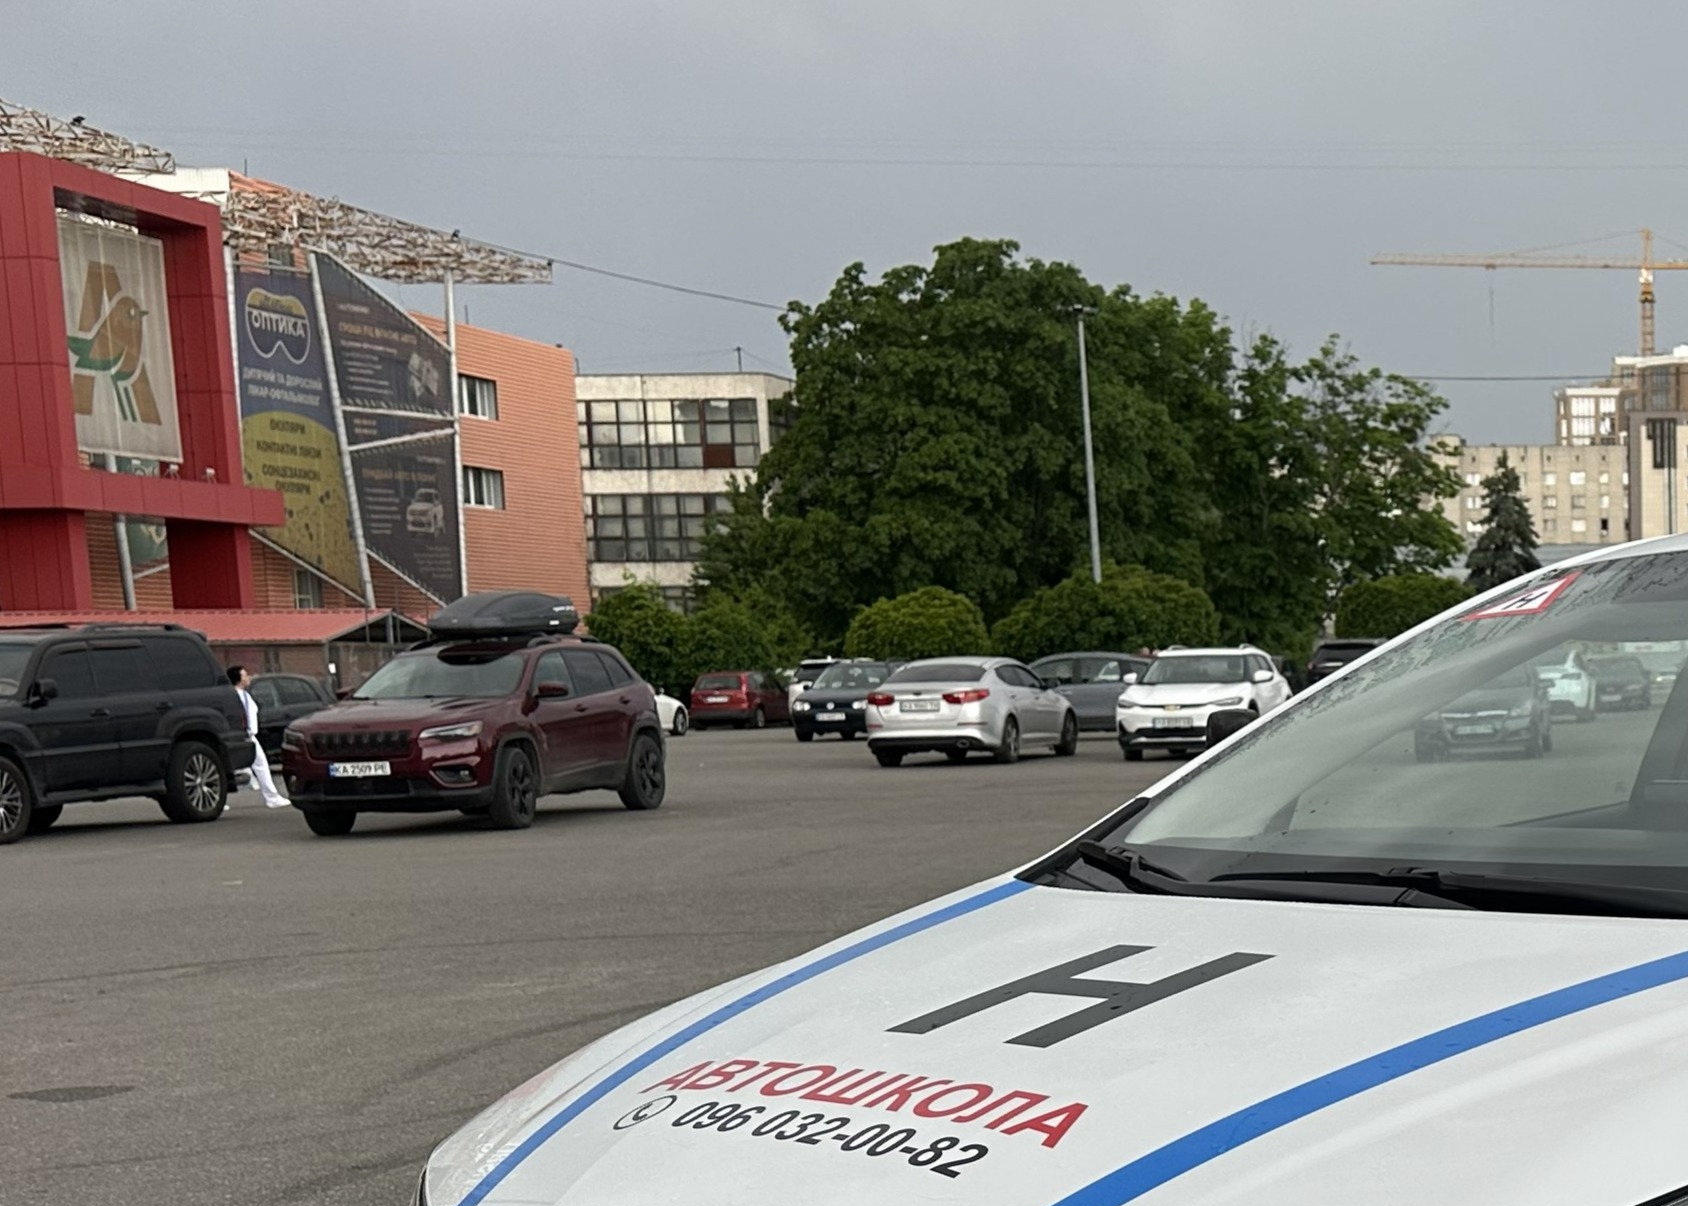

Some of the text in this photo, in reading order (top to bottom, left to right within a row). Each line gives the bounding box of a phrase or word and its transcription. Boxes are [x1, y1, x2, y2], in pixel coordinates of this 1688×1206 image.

[251, 311, 306, 338] ОПТИКА
[883, 944, 1278, 1049] Н
[638, 1058, 1089, 1149] АВТОШКОЛА
[672, 1100, 988, 1178] 096 032-00-82
